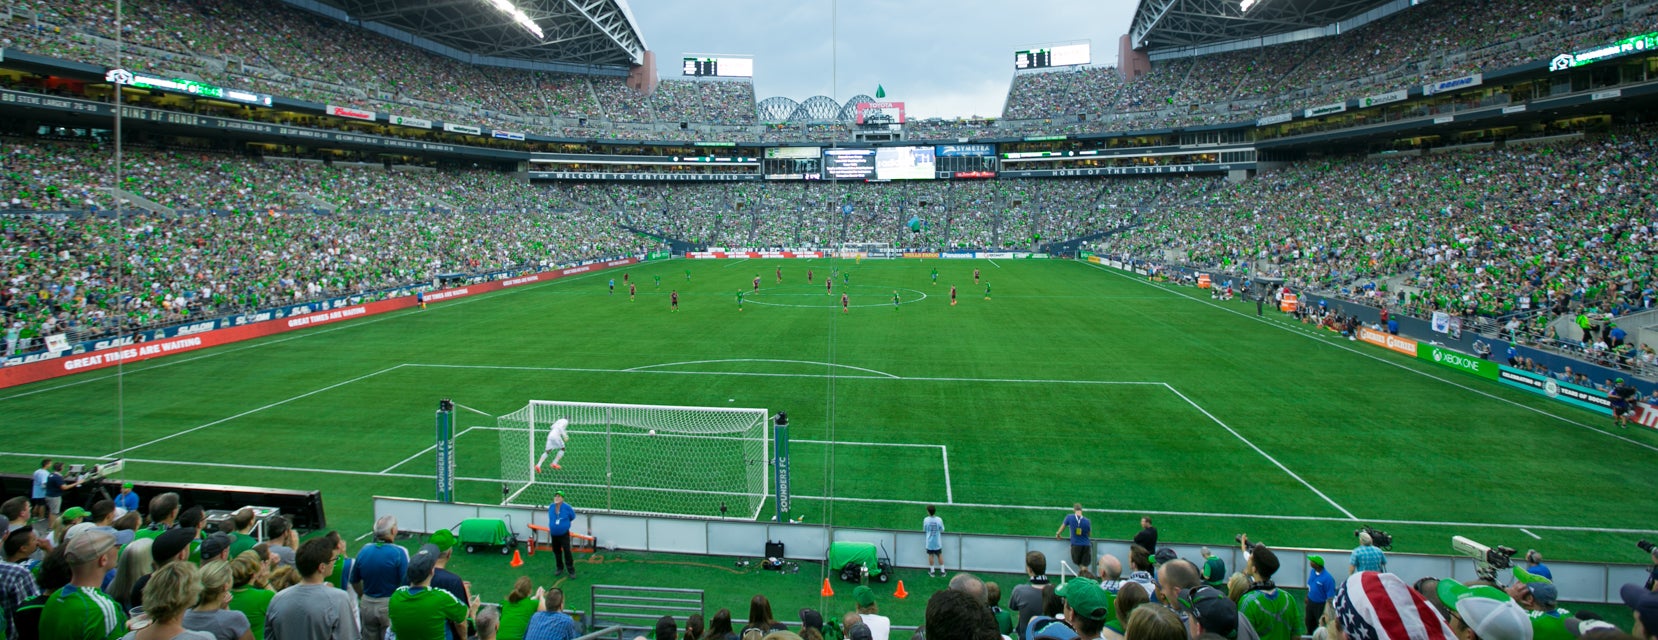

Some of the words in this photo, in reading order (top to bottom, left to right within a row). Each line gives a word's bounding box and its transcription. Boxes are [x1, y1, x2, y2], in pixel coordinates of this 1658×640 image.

[122, 108, 146, 119] RING
[151, 110, 163, 121] OF
[168, 112, 199, 124] HONOR
[288, 317, 309, 327] GREAT
[64, 354, 102, 370] GREAT
[104, 348, 138, 362] TIMES
[139, 344, 161, 356] ARE
[161, 337, 202, 352] WAITING
[1443, 353, 1462, 366] XBOX
[1463, 359, 1479, 371] ONE
[1561, 388, 1578, 399] YEARS
[1579, 392, 1588, 400] OF
[1588, 395, 1611, 407] SOCCER
[780, 457, 786, 468] FC
[780, 469, 788, 513] SOUNDERS
